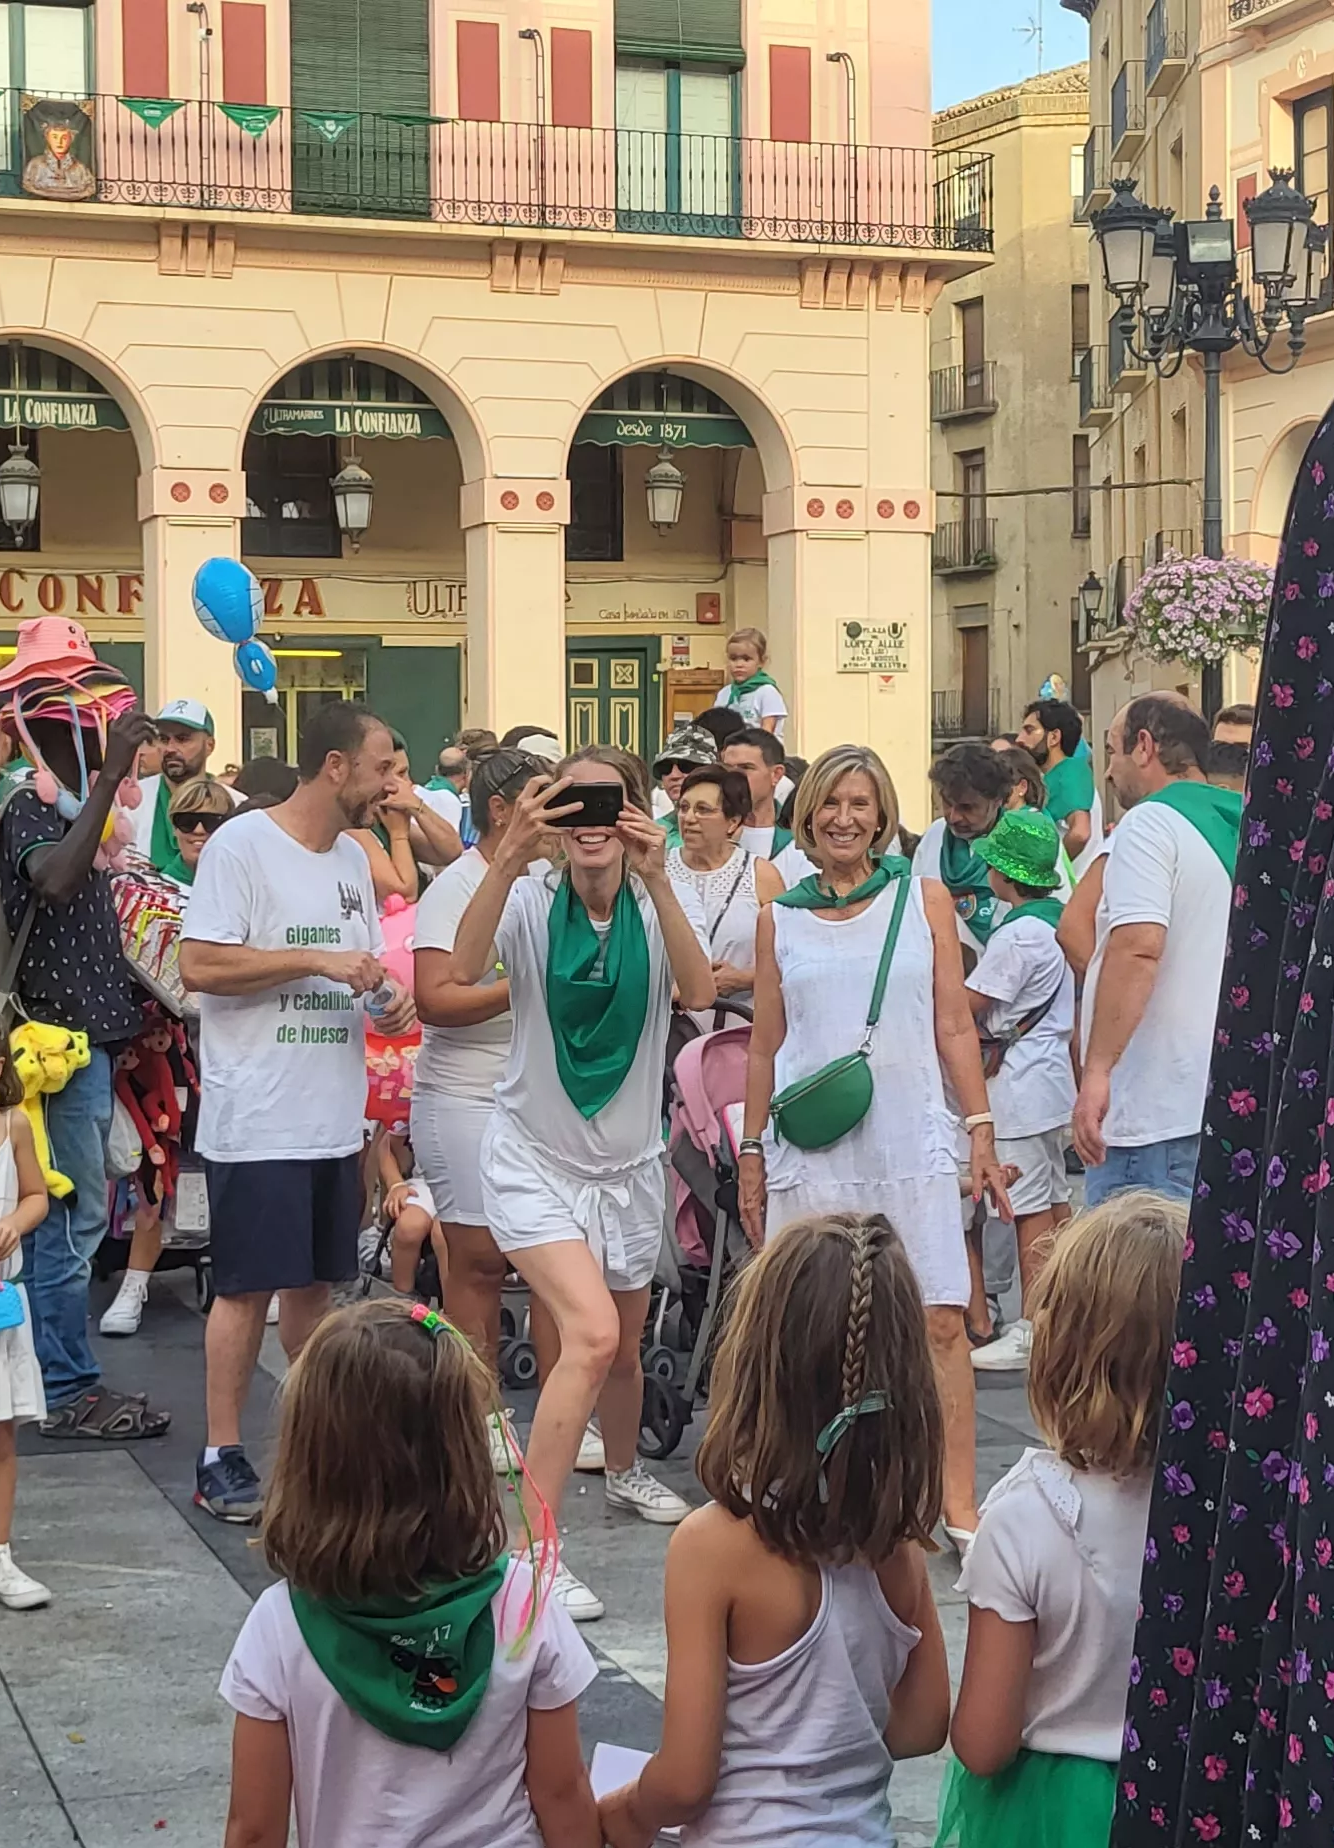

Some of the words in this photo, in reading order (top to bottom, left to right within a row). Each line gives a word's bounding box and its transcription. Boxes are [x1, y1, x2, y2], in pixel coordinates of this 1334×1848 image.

[4, 397, 20, 423] LA
[25, 399, 97, 425] CONFIANZA
[335, 408, 351, 432] LA
[355, 409, 422, 434] CONFIANZA
[616, 419, 653, 436] desde
[660, 423, 687, 441] 1871
[279, 993, 289, 1012] y
[277, 1024, 296, 1043] de
[301, 1025, 348, 1043] huesca
